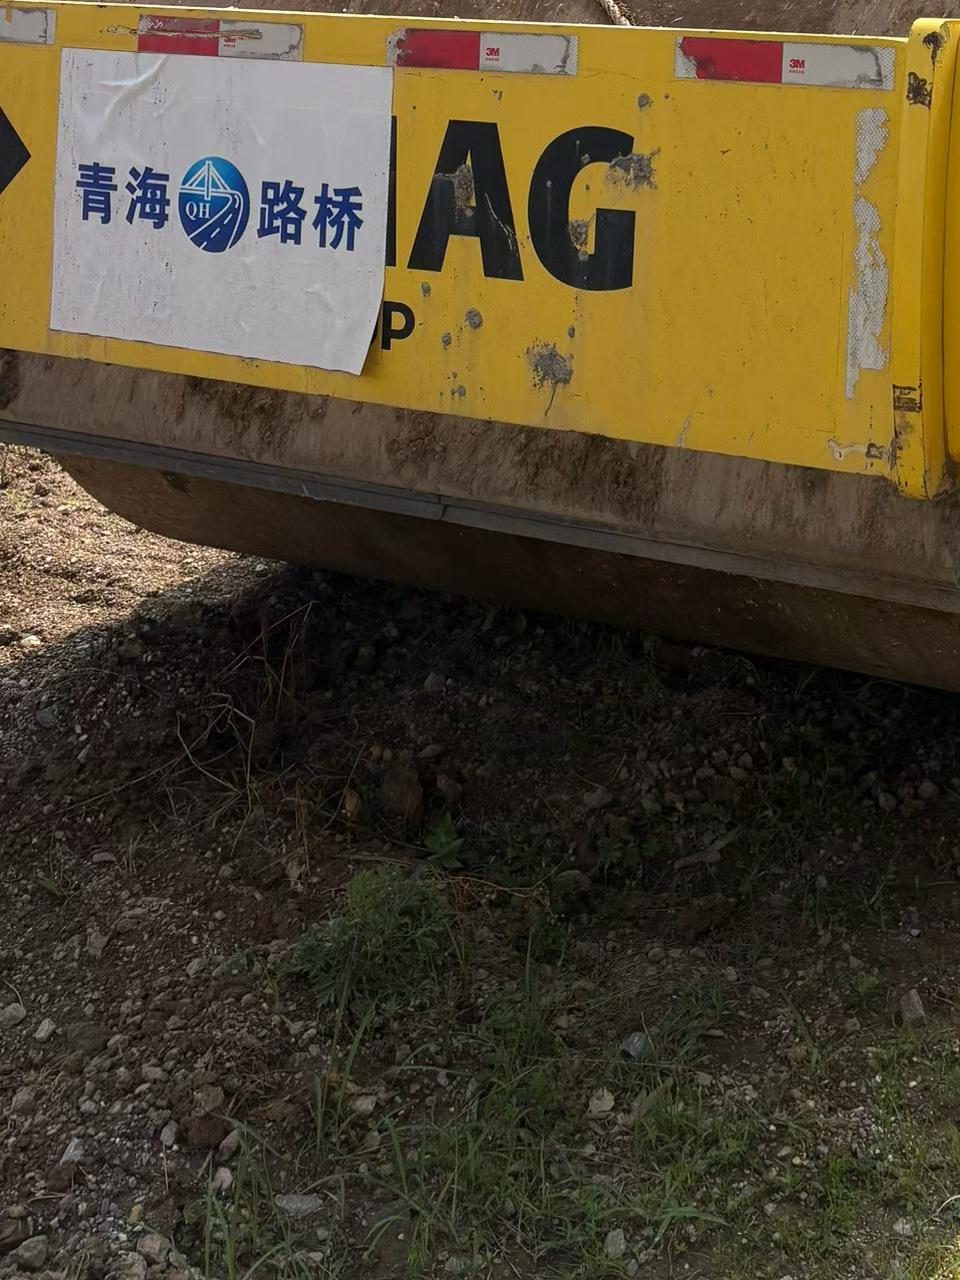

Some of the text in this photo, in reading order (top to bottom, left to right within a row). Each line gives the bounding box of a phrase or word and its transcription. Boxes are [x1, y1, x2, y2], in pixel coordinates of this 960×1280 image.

[485, 47, 500, 57] 3M
[789, 59, 805, 69] 3M
[185, 201, 211, 221] QH
[385, 115, 637, 292] AG
[372, 301, 416, 350] P
